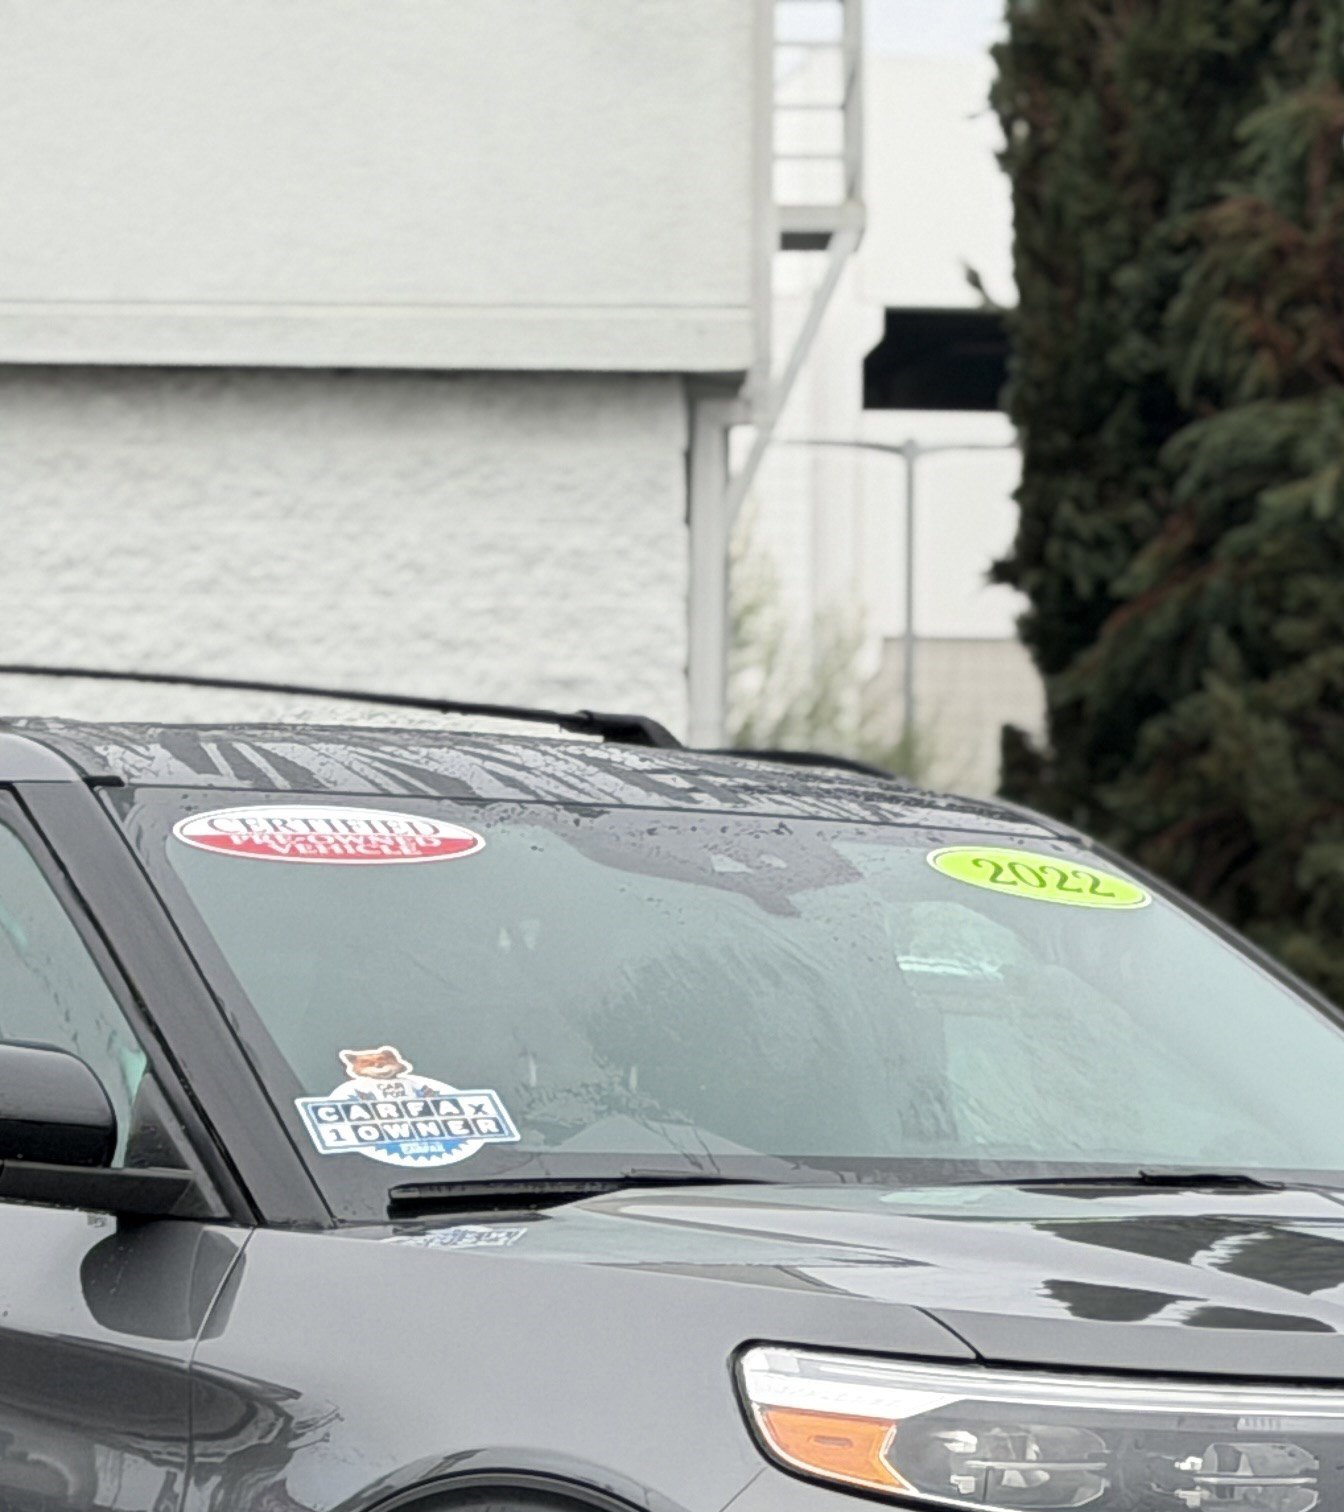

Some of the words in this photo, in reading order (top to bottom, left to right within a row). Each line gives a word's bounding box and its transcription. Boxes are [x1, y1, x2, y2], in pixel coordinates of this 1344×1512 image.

[207, 816, 440, 838] CERTIFIED
[229, 833, 442, 849] PRE-OWNED
[268, 842, 424, 856] VEHICLE
[971, 858, 1116, 898] 2022
[316, 1100, 490, 1122] CARFAX
[328, 1128, 347, 1142] 1
[356, 1118, 500, 1141] OWNER
